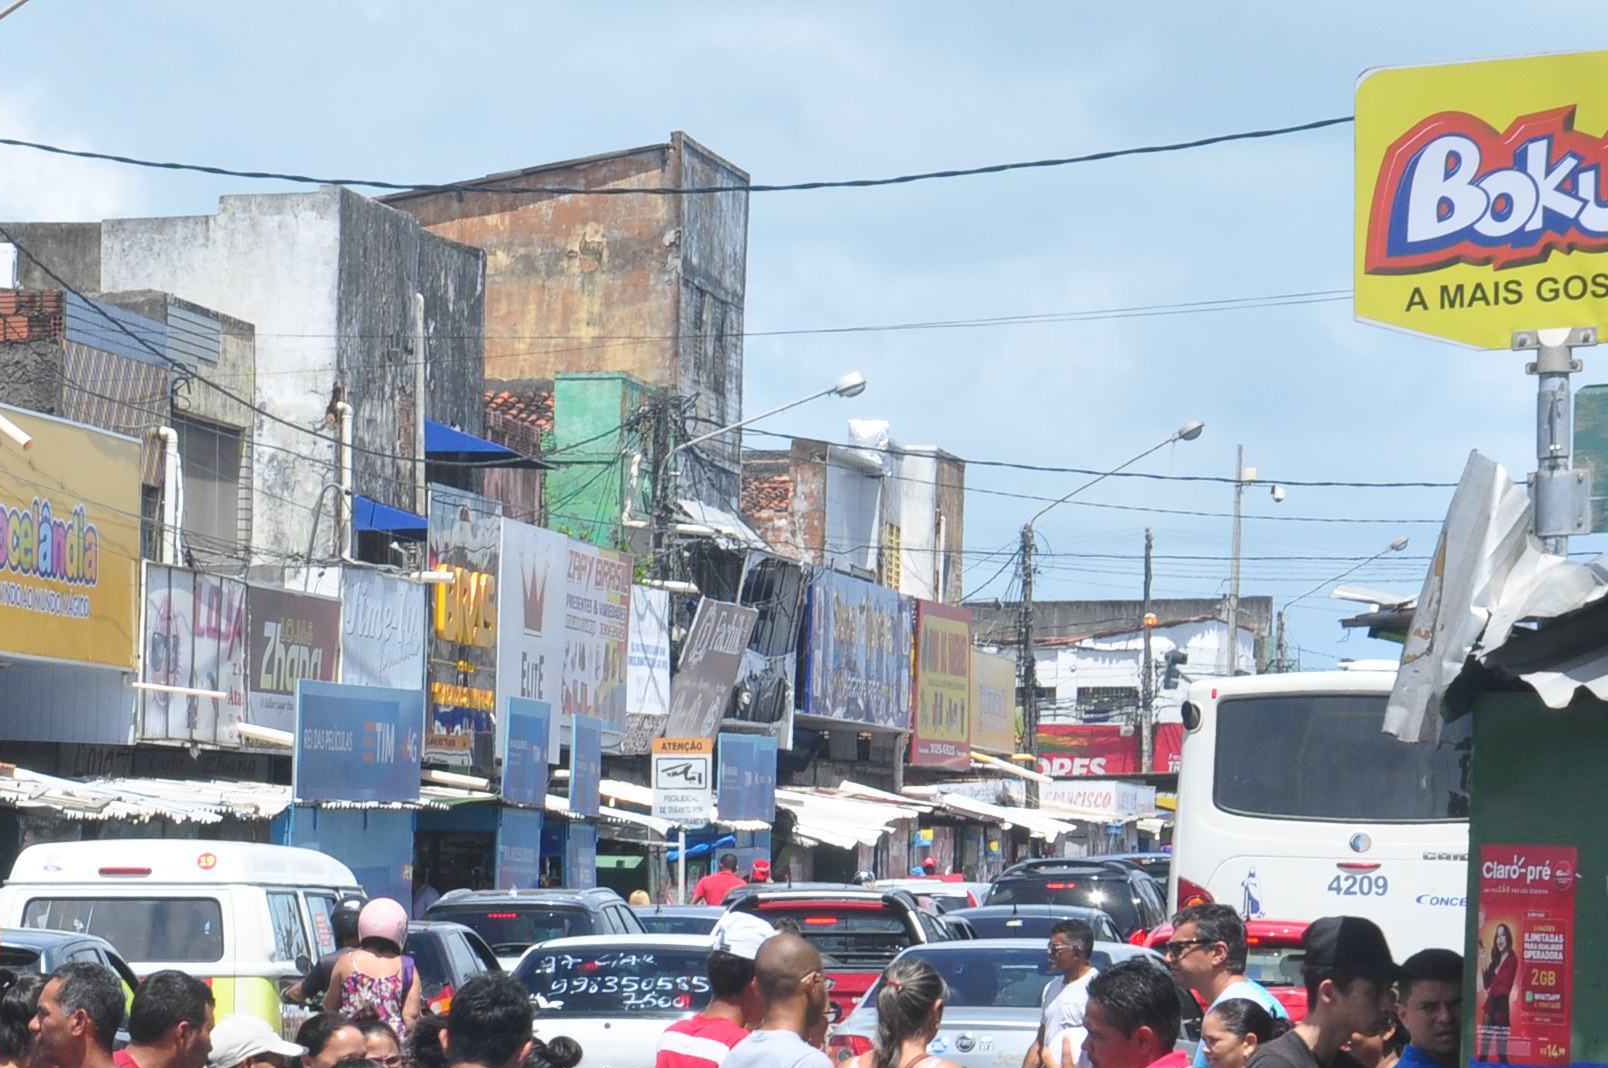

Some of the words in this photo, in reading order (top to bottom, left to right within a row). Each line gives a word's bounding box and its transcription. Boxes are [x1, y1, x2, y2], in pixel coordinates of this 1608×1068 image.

[1405, 286, 1429, 312] A
[1439, 279, 1523, 310] MAIS
[375, 721, 396, 764] TIM
[660, 740, 703, 752] ATENÇÃO
[199, 855, 216, 867] 19
[1327, 874, 1389, 897] 4209
[1523, 950, 1564, 960] OPERADORA
[1531, 968, 1556, 986] 2GB
